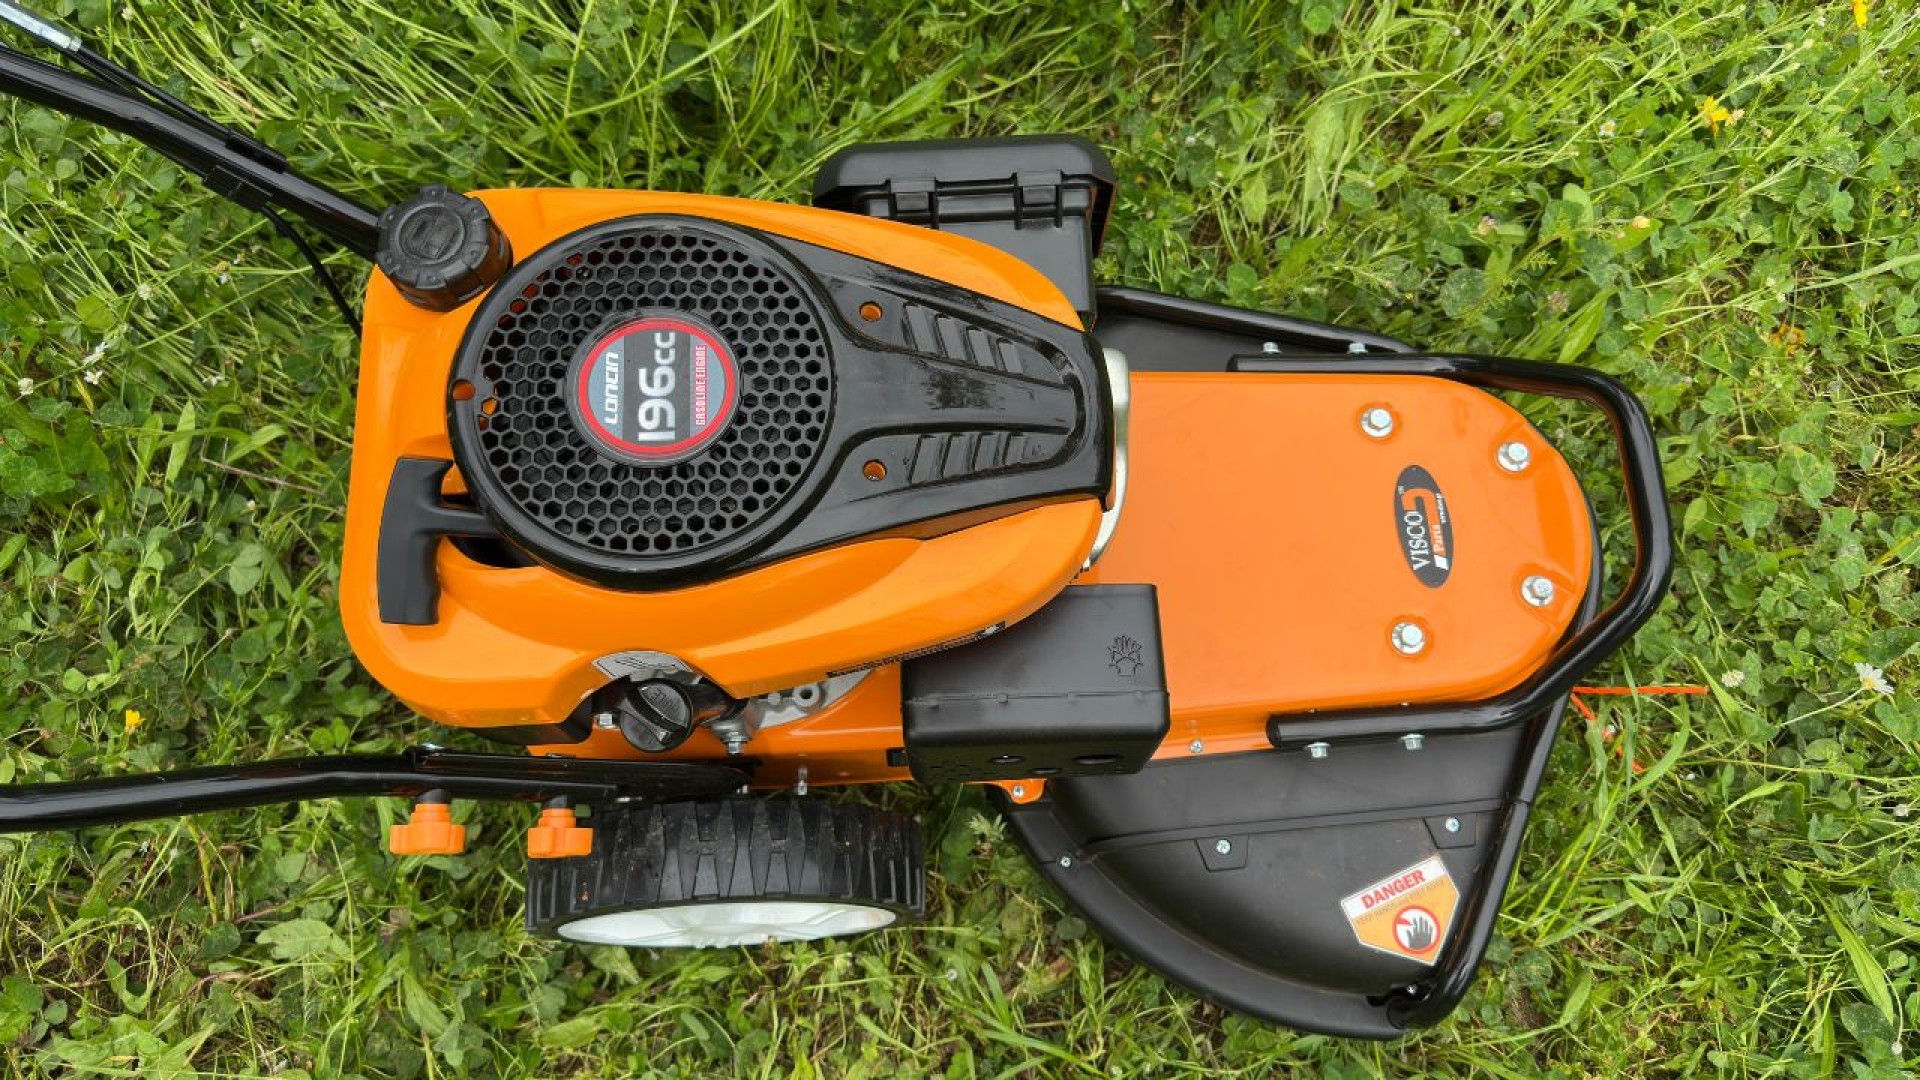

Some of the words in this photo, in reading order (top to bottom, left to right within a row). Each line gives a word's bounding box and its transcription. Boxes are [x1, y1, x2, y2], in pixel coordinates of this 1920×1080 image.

[638, 332, 676, 442] 196cc
[695, 345, 706, 378] ENGINE
[605, 352, 619, 424] LONCIN
[695, 379, 706, 425] GASOLINE
[1404, 511, 1430, 570] VISCO
[1361, 869, 1425, 909] DANGER
